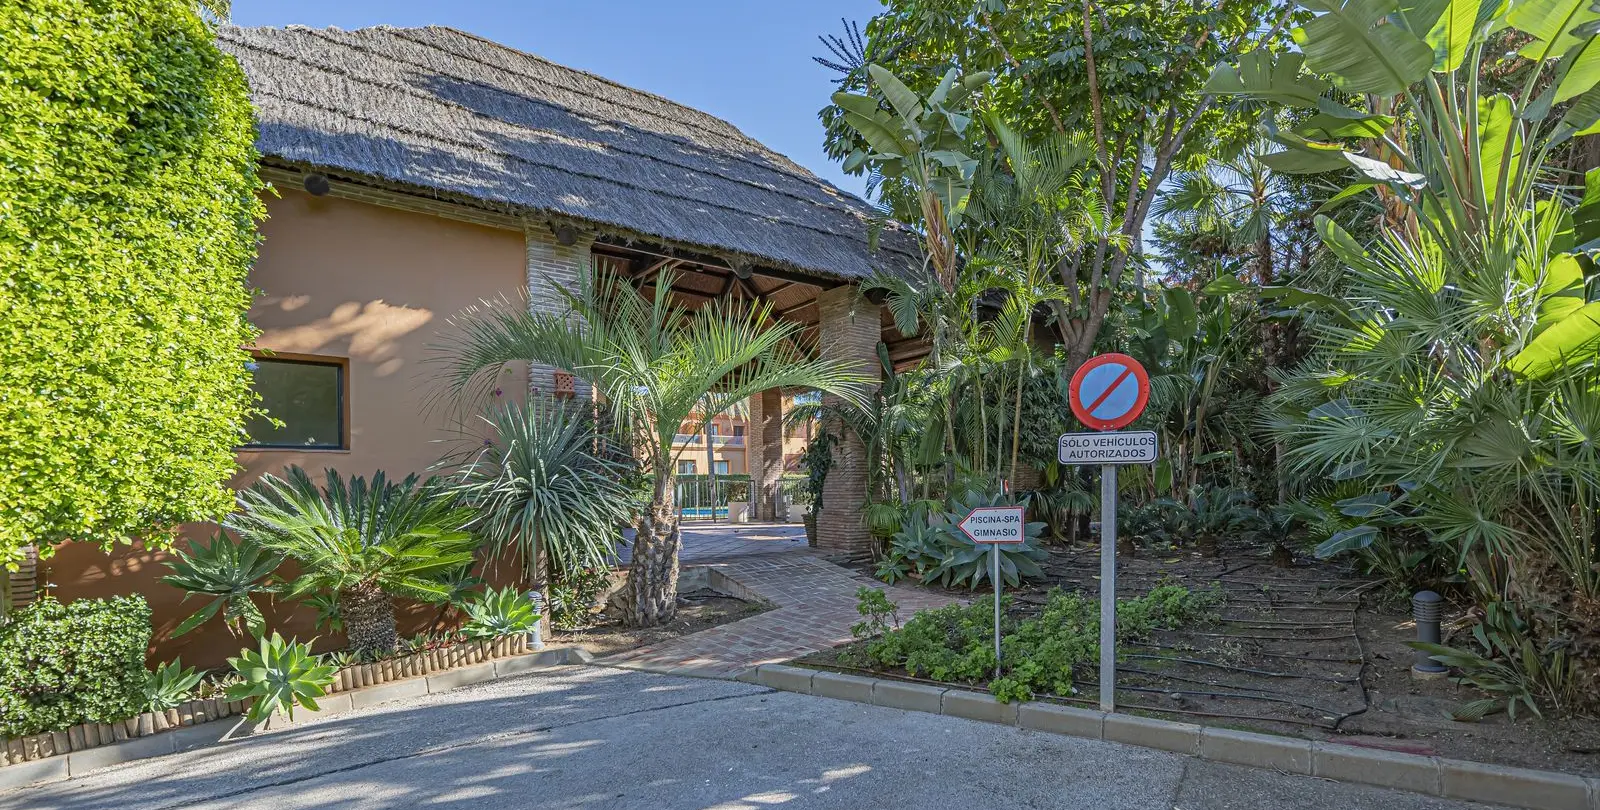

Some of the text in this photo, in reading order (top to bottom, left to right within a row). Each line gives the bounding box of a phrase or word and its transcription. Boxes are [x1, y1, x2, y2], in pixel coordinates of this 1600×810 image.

[1062, 436, 1155, 448] SÓLO VEHÍCULOS
[1069, 449, 1146, 459] AUTORIZADOS
[970, 515, 1020, 524] PISCINA-SPA
[973, 528, 1018, 537] GIMNASIO
